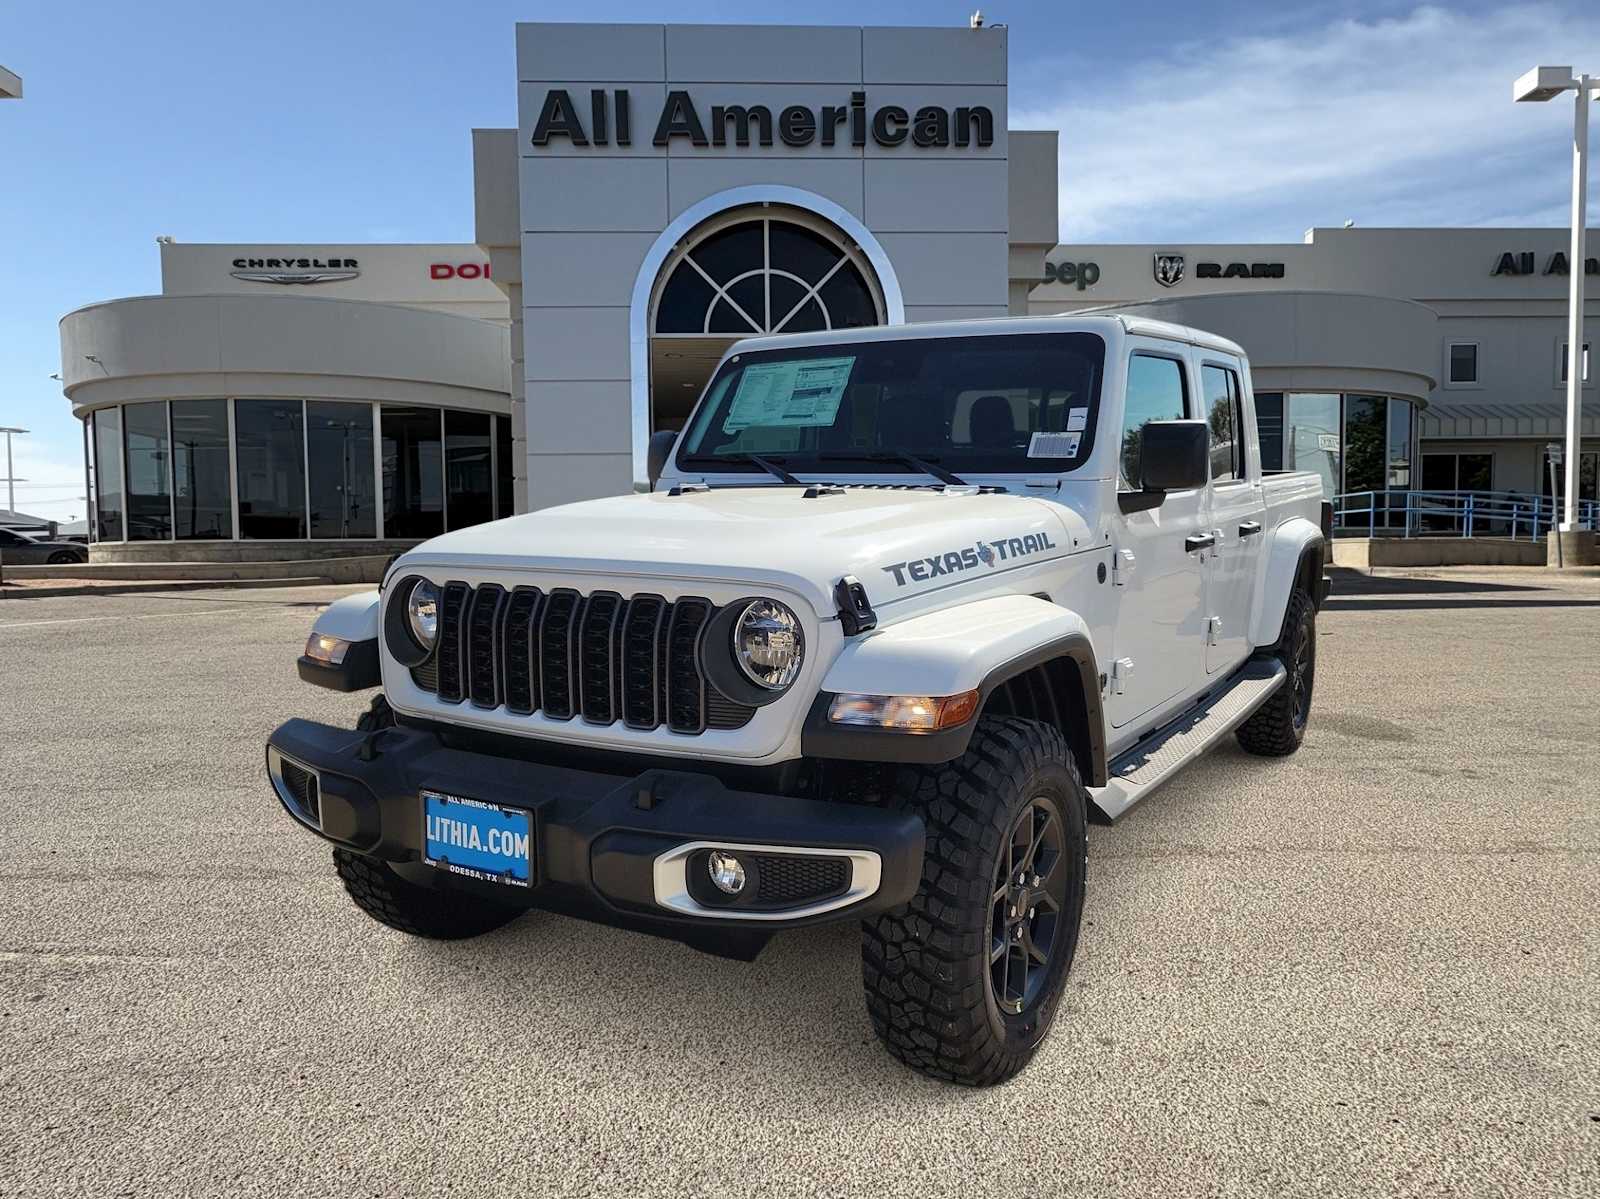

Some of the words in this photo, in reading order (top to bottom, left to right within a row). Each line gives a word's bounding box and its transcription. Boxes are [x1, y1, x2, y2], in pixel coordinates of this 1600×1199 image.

[532, 89, 632, 147] All
[652, 90, 994, 147] American
[232, 258, 359, 269] CHRYSLER
[431, 263, 490, 280] DO
[1196, 263, 1285, 279] RAM
[1490, 252, 1535, 276] All
[880, 547, 979, 587] TEXAS
[990, 532, 1056, 561] TRAIL
[447, 795, 460, 804] ALL
[426, 815, 530, 860] LITHIA.COM
[449, 865, 484, 880] ODESSA,
[486, 873, 498, 882] TX
